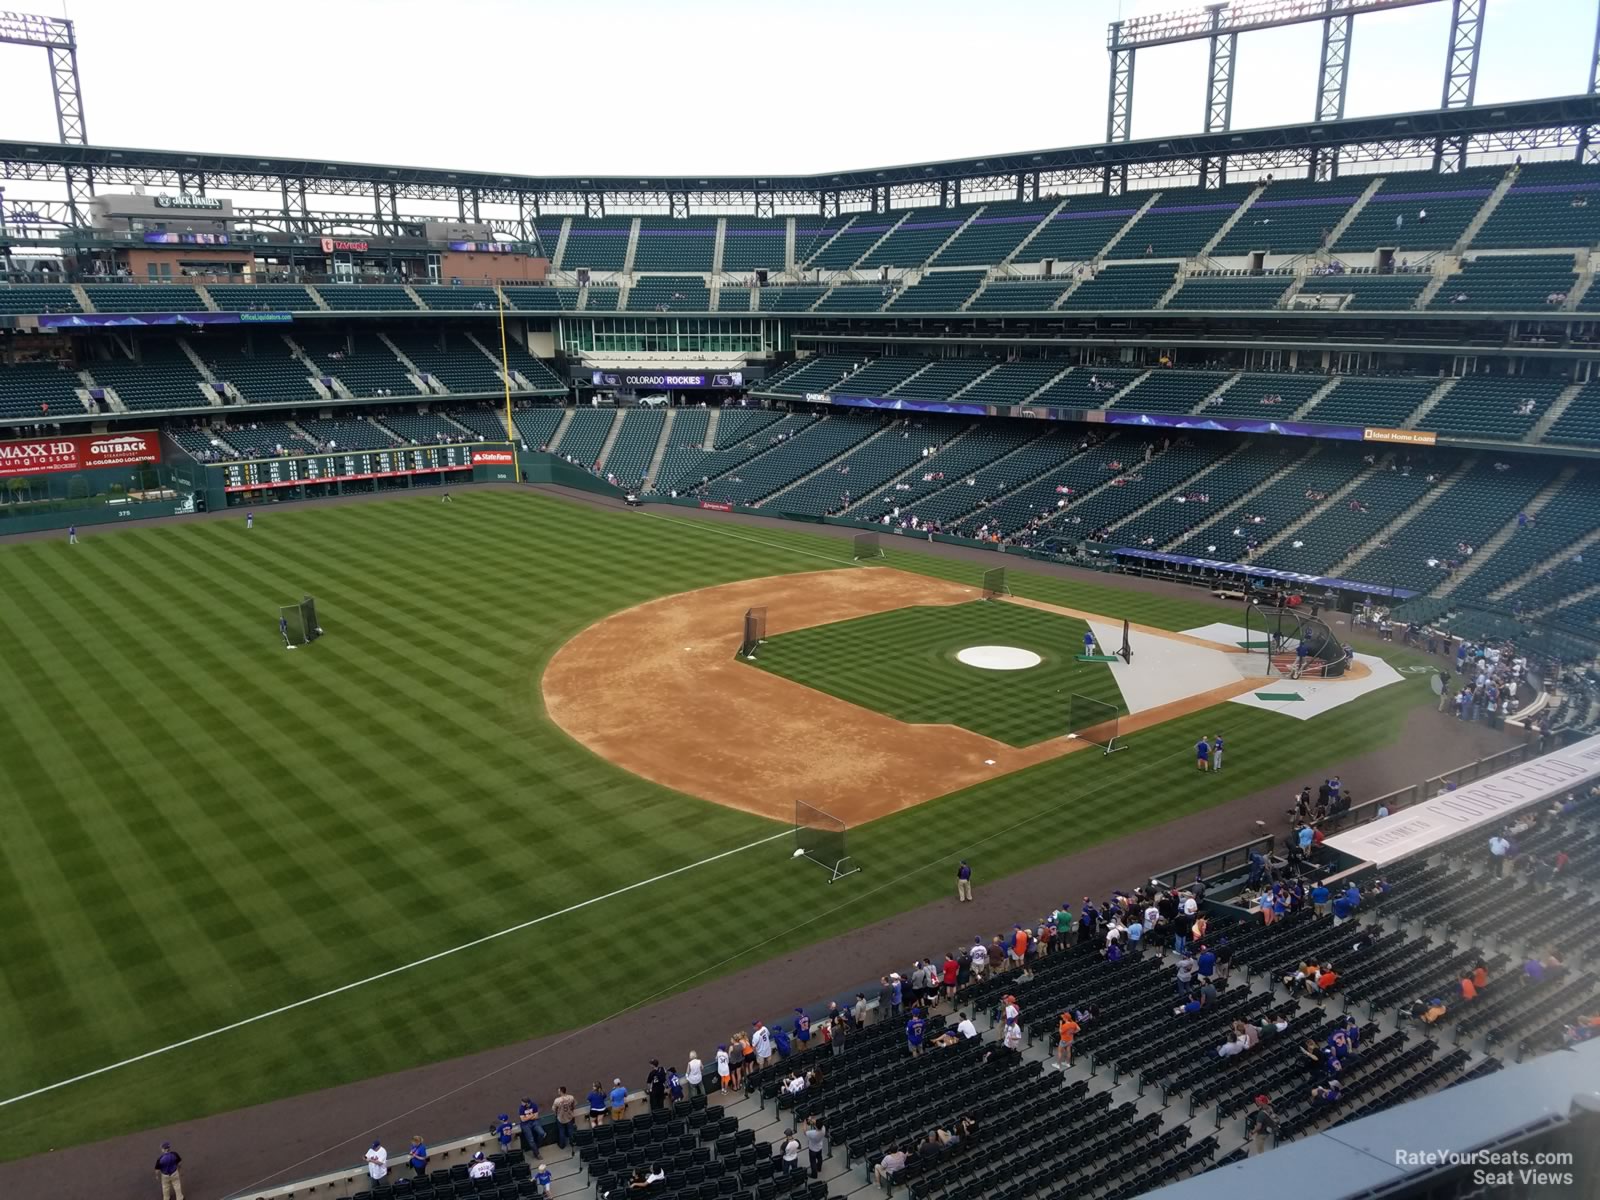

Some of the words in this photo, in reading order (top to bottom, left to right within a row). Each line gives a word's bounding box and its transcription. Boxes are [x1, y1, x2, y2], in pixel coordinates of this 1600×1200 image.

[172, 195, 191, 205] JACK
[626, 376, 665, 384] COLORADO
[666, 376, 701, 384] ROCKIES
[1373, 431, 1390, 439] Ideal
[0, 444, 48, 459] MAXX
[50, 442, 75, 455] HD
[91, 442, 146, 454] OUTBACK
[1426, 783, 1525, 823] COORS
[1502, 758, 1588, 792] FIELD
[1365, 823, 1415, 848] WELCOME
